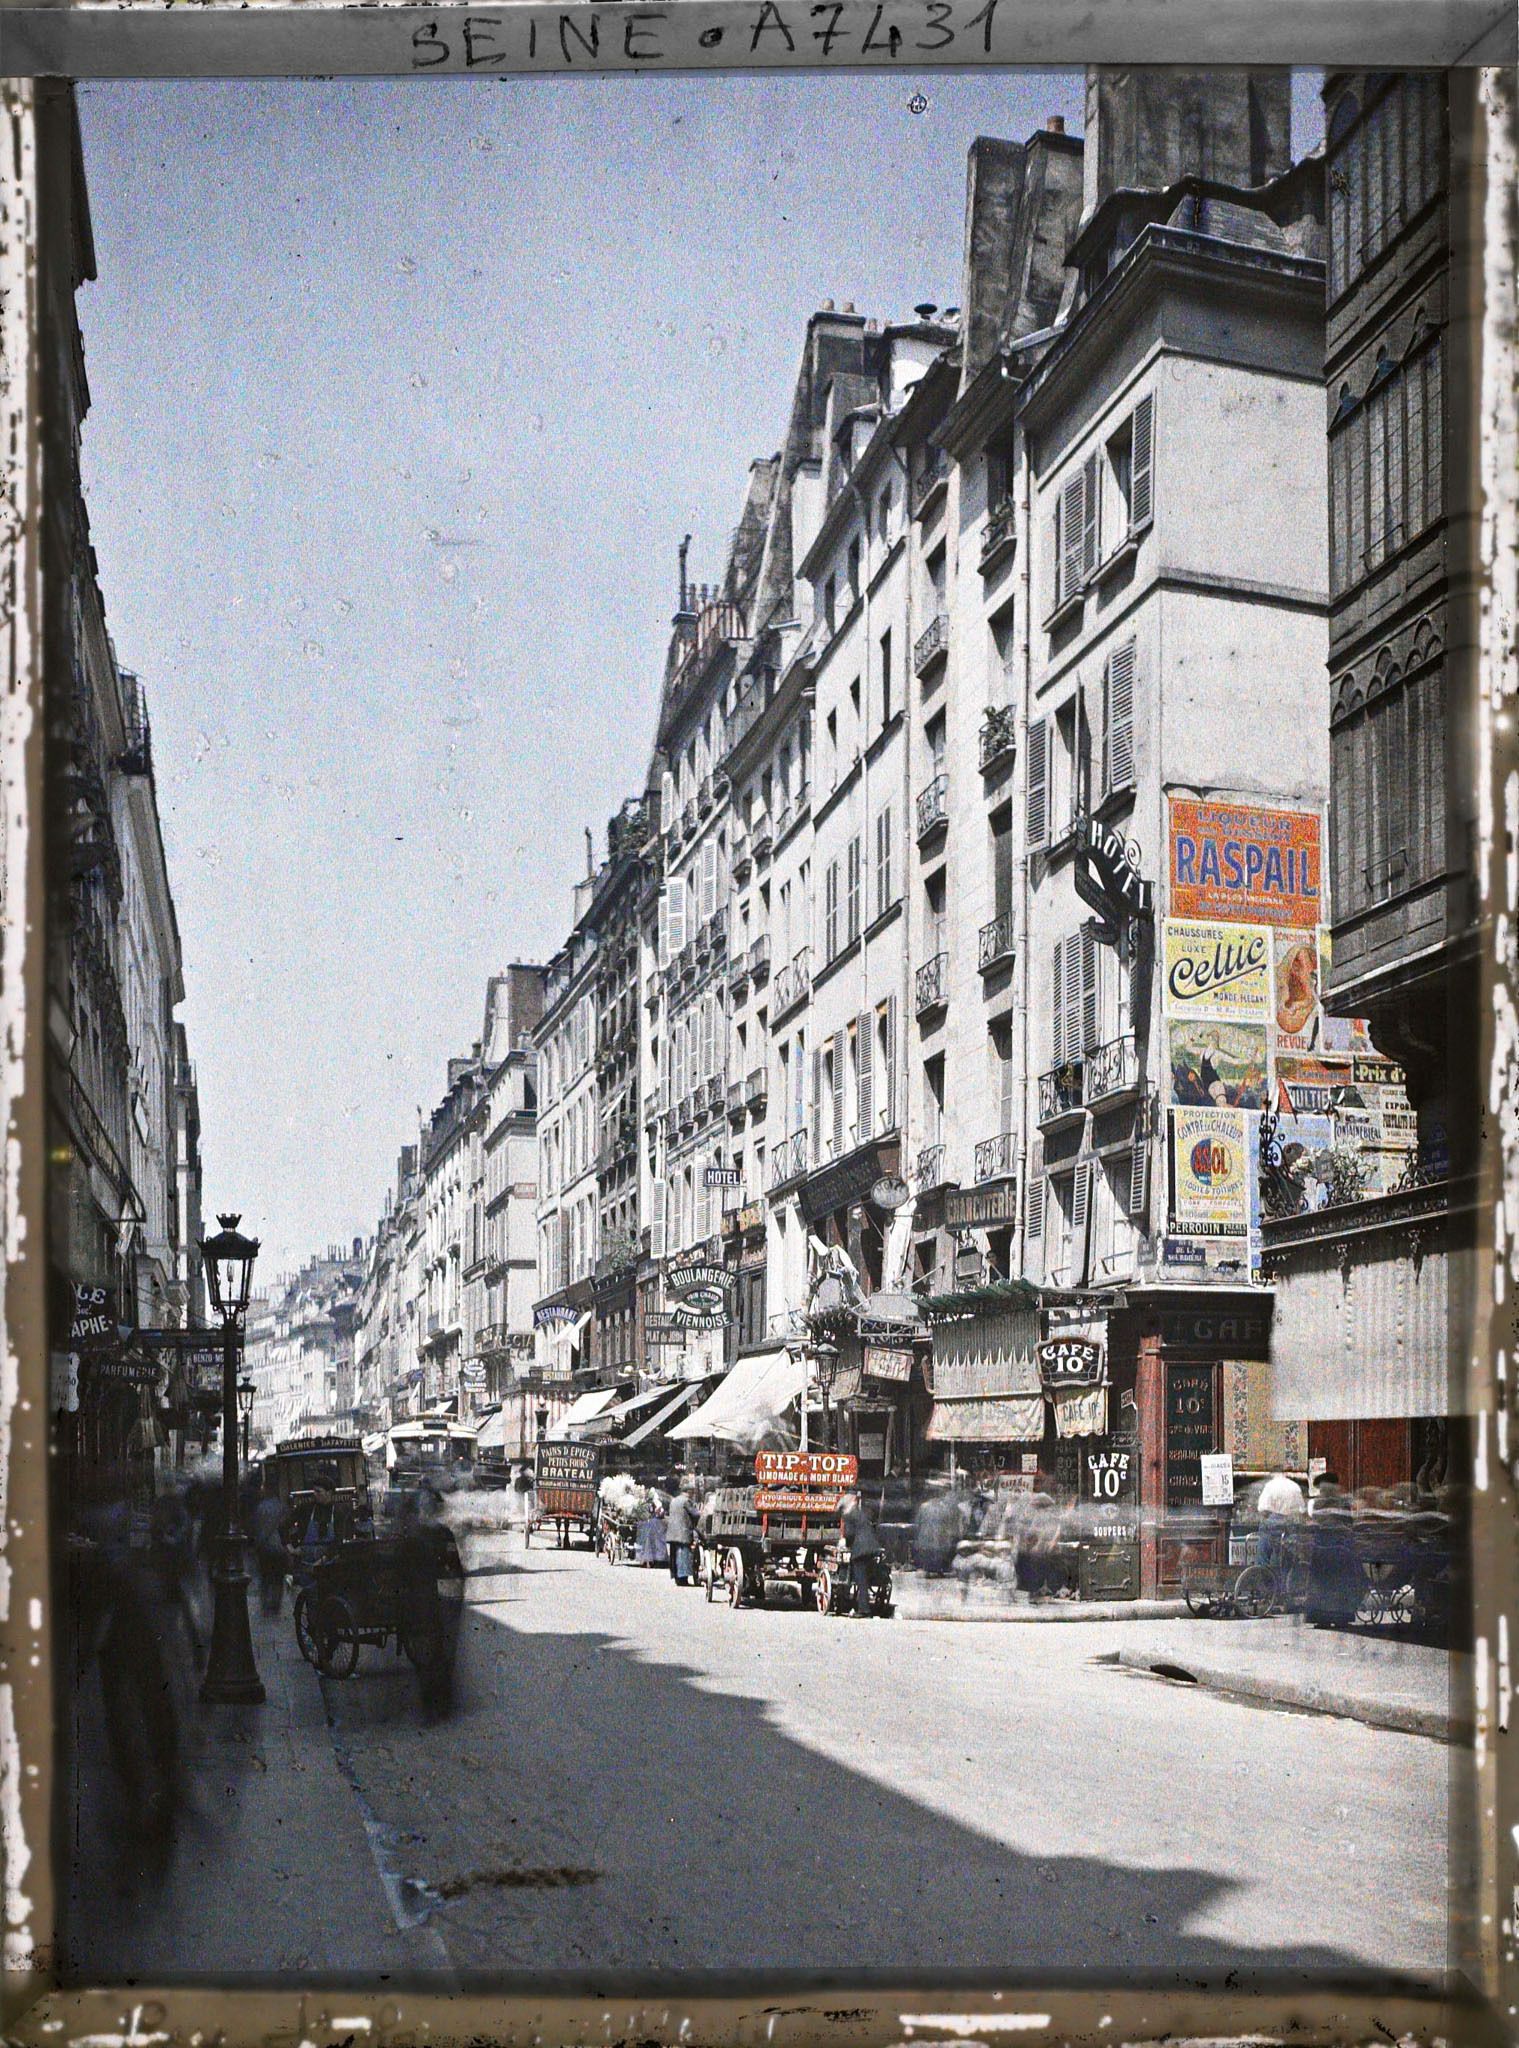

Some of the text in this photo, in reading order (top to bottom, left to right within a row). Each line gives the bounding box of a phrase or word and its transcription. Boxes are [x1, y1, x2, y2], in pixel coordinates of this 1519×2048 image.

[410, 0, 998, 68] SEINE A7431
[1197, 811, 1292, 831] LIQUEUR
[1176, 835, 1318, 897] RASPAIL
[1167, 926, 1224, 941] CHAUSSURES
[1181, 944, 1207, 954] LUXE
[1168, 934, 1267, 1000] Celtic
[1213, 991, 1241, 1002] MONDE
[1277, 1034, 1307, 1049] REVUE
[1183, 1110, 1236, 1119] PROTECTION
[707, 1170, 740, 1185] HOTEL
[671, 1267, 736, 1289] BOULANGERIE
[536, 1306, 578, 1321] RESTAURANT
[676, 1310, 730, 1329] VIENNOISE
[101, 1364, 158, 1378] PARFUMERIE
[1056, 1356, 1084, 1373] 10
[321, 1438, 360, 1449] LAFAYETTE
[541, 1446, 562, 1459] PAINS
[762, 1453, 850, 1473] TIP-TOP
[1087, 1452, 1130, 1470] CAFE
[542, 1467, 594, 1480] BRATEAU
[759, 1471, 799, 1481] LIMONADE
[810, 1473, 830, 1482] MONT
[832, 1474, 855, 1484] BLANC
[1093, 1525, 1127, 1537] SOUPERS
